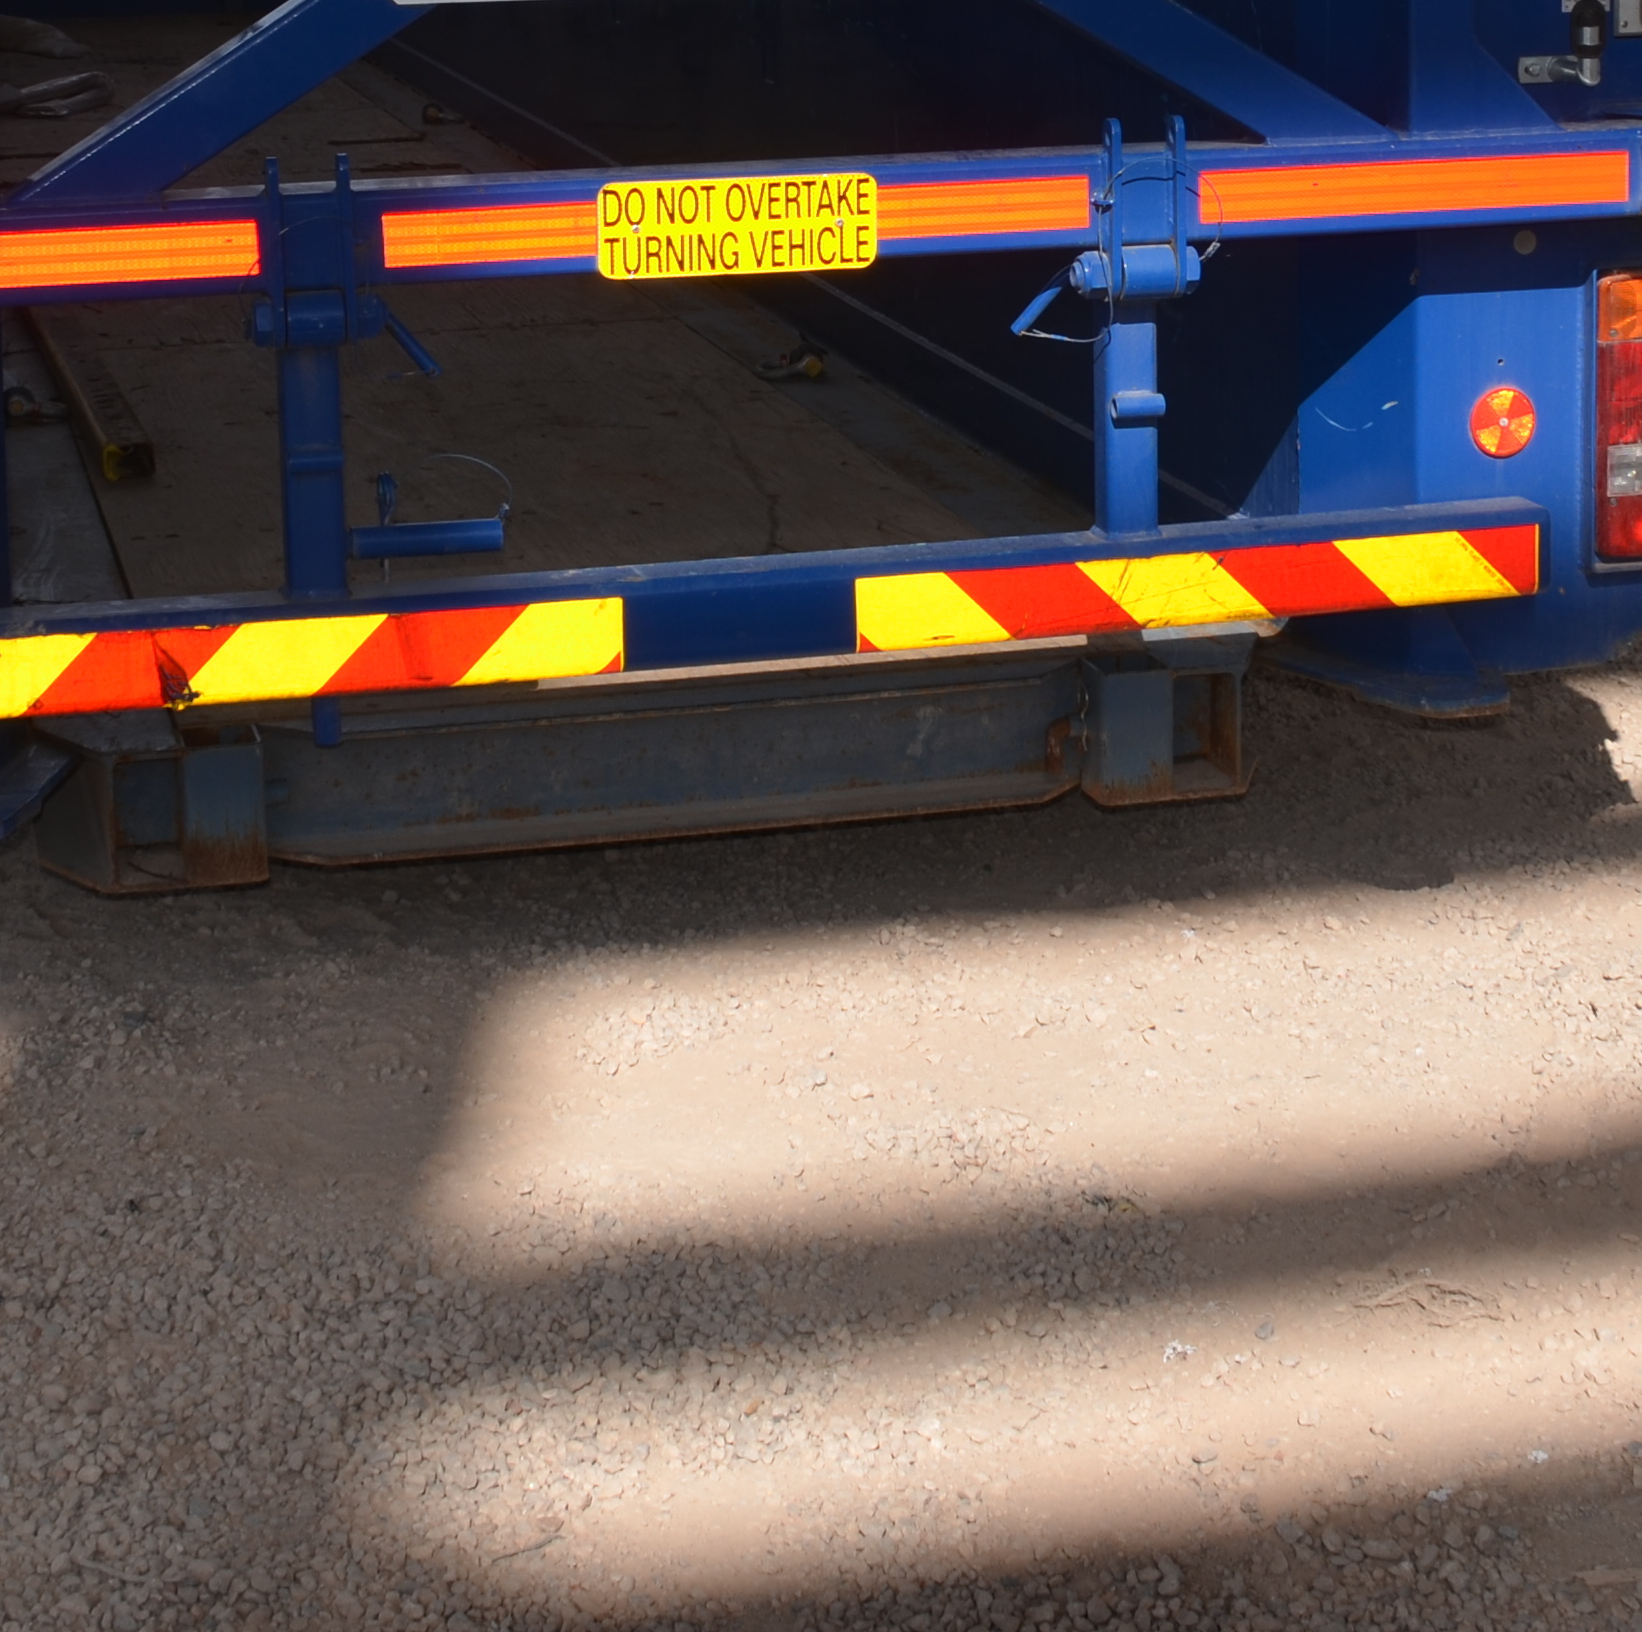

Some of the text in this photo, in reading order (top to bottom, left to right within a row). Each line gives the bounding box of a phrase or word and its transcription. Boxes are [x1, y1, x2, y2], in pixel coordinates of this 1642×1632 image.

[603, 177, 870, 228] DO NOT OVERTAKE
[603, 225, 870, 275] TURNING VEHICLE
